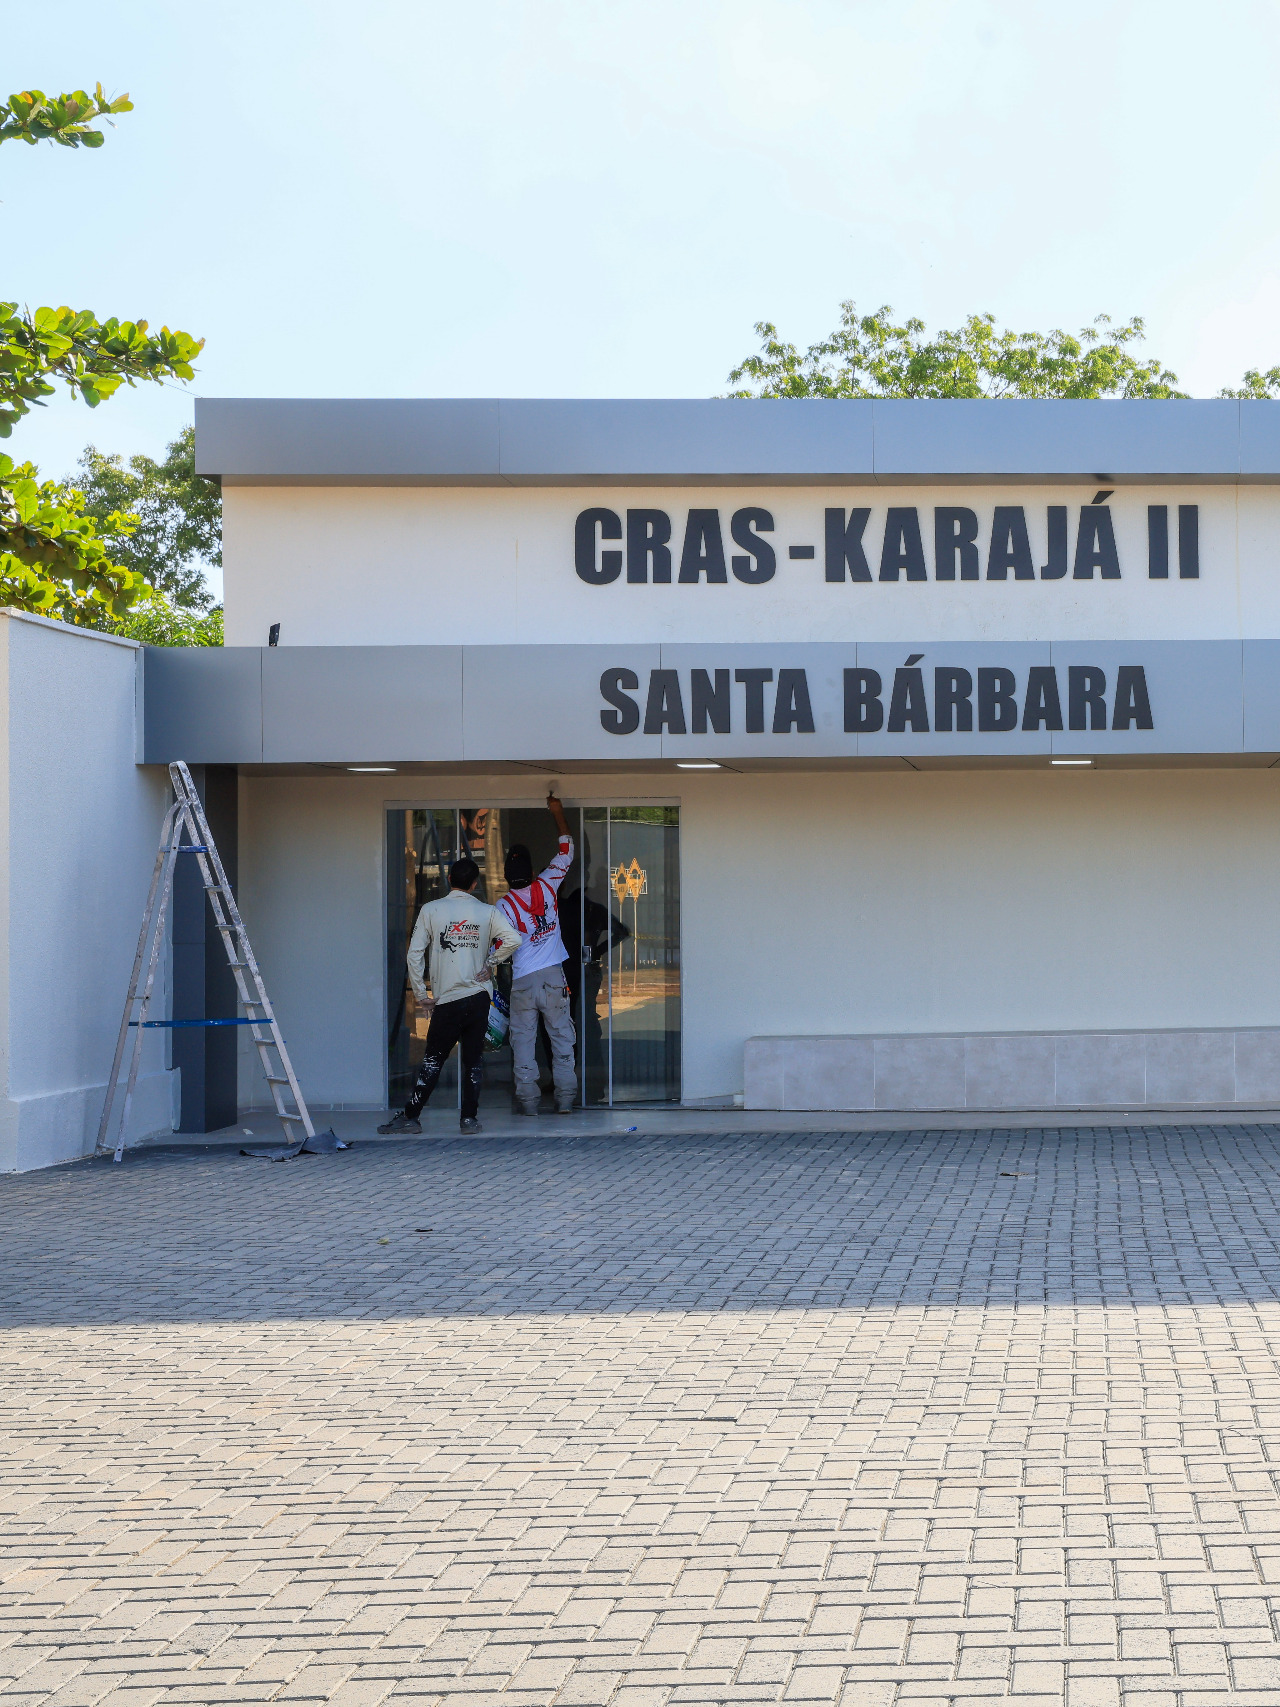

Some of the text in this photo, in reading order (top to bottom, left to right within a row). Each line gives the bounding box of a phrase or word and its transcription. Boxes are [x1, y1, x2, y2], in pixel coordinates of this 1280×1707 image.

[1148, 504, 1200, 579] II
[599, 653, 1154, 735] SANTA BÁRBARA
